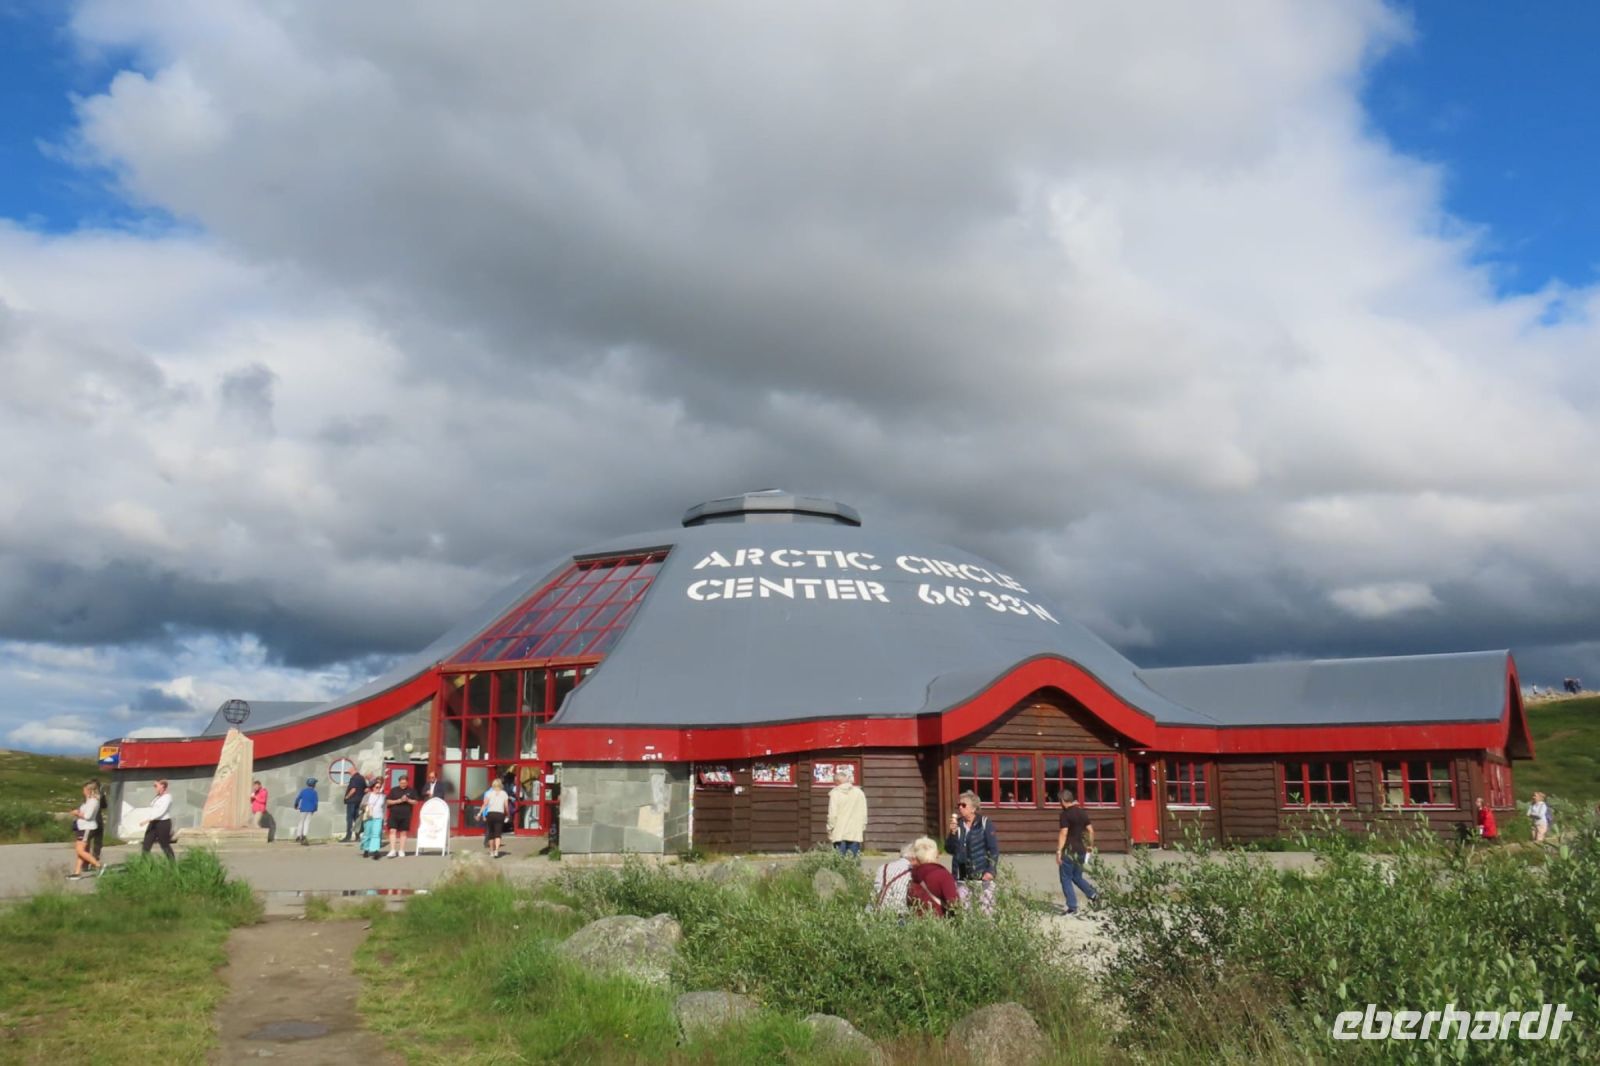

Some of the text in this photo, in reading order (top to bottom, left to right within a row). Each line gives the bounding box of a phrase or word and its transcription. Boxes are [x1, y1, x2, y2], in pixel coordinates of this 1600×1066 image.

[693, 548, 1029, 593] ARCTIC CIRCLE
[687, 577, 890, 603] CENTER
